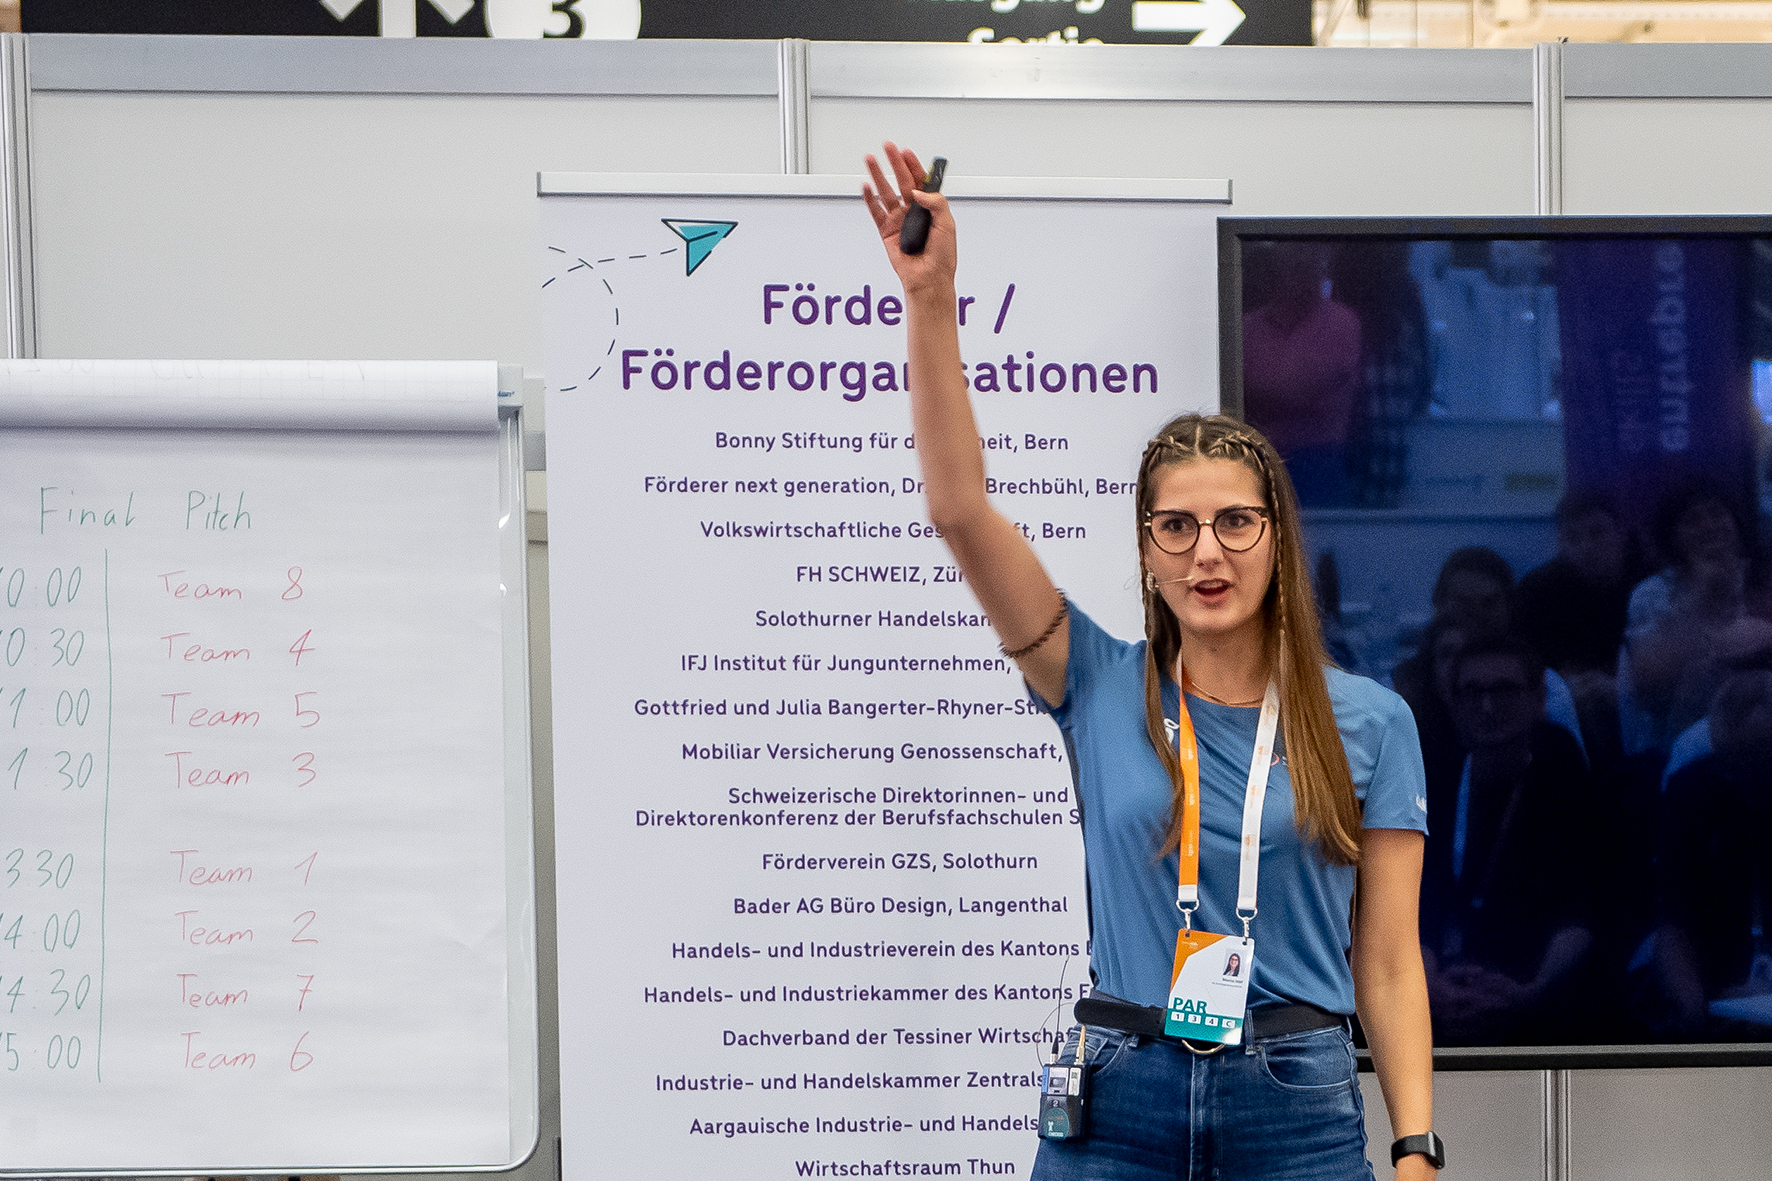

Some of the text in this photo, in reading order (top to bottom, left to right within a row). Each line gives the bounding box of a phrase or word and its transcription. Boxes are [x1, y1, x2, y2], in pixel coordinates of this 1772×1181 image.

[763, 283, 976, 327] Förder
[621, 348, 1159, 403] Förderorgaationen
[715, 431, 776, 453] Bonny
[781, 432, 863, 453] Stiftung
[869, 432, 898, 449] für
[1024, 433, 1069, 451] Bern
[644, 476, 729, 494] Förderer
[735, 478, 778, 494] next
[783, 476, 896, 498] generation,
[985, 477, 1089, 498] Brechbühl,
[40, 487, 252, 534] Final Pitch
[700, 521, 902, 539] Volkswirtschaftliche
[1042, 522, 1086, 539] Bern
[157, 569, 243, 600] Team
[281, 566, 303, 601] 8
[796, 565, 822, 582] FH
[828, 565, 927, 586] SCHWEIZ,
[755, 610, 872, 627] Solothurner
[160, 632, 250, 662] Team
[289, 629, 316, 666] 4
[681, 654, 1012, 676] IFJ Institut für Jungunternehmen,
[161, 692, 260, 727] Team
[294, 691, 320, 728] 5
[634, 698, 727, 716] Gottfried
[733, 699, 770, 716] und
[776, 698, 822, 716] Julia
[682, 742, 1064, 764] Mobiliar Versicherung Genossenschaft,
[165, 751, 250, 788] Team
[292, 752, 316, 787] 3
[728, 786, 1069, 804] Schweizerische Direktorinnen- und
[636, 809, 839, 827] Direktorenkonferenz
[844, 809, 876, 826] der
[882, 808, 1063, 826] Berufsfachschulen
[170, 849, 253, 886] Team
[294, 851, 318, 886] 1
[762, 852, 1038, 873] Förderverein GZS, Solothurn
[733, 896, 1068, 918] Bader AG Büro Design, Langenthal
[174, 909, 254, 945] Team
[291, 910, 319, 943] 2
[672, 942, 761, 959] Handels-
[767, 941, 804, 959] und
[810, 940, 956, 958] Industrieverein
[961, 940, 995, 957] des
[1000, 940, 1080, 957] Kantons
[176, 973, 249, 1008] Team
[296, 974, 315, 1012] 7
[644, 986, 733, 1003] Handels-
[740, 985, 776, 1003] und
[782, 984, 949, 1002] Industriekammer
[954, 984, 988, 1001] des
[994, 984, 1073, 1001] Kantons
[1173, 997, 1208, 1014] PAR
[723, 1028, 850, 1047] Dachverband
[855, 1028, 888, 1045] der
[892, 1027, 973, 1045] Tessiner
[181, 1031, 257, 1069] Team
[290, 1031, 314, 1071] 6
[656, 1073, 754, 1091] Industrie-
[760, 1073, 797, 1090] und
[803, 1072, 961, 1090] Handelskammer
[689, 1114, 1038, 1138] Aargauische Industrie- und Handels
[795, 1158, 1015, 1177] Wirtschaftsraum Thun
